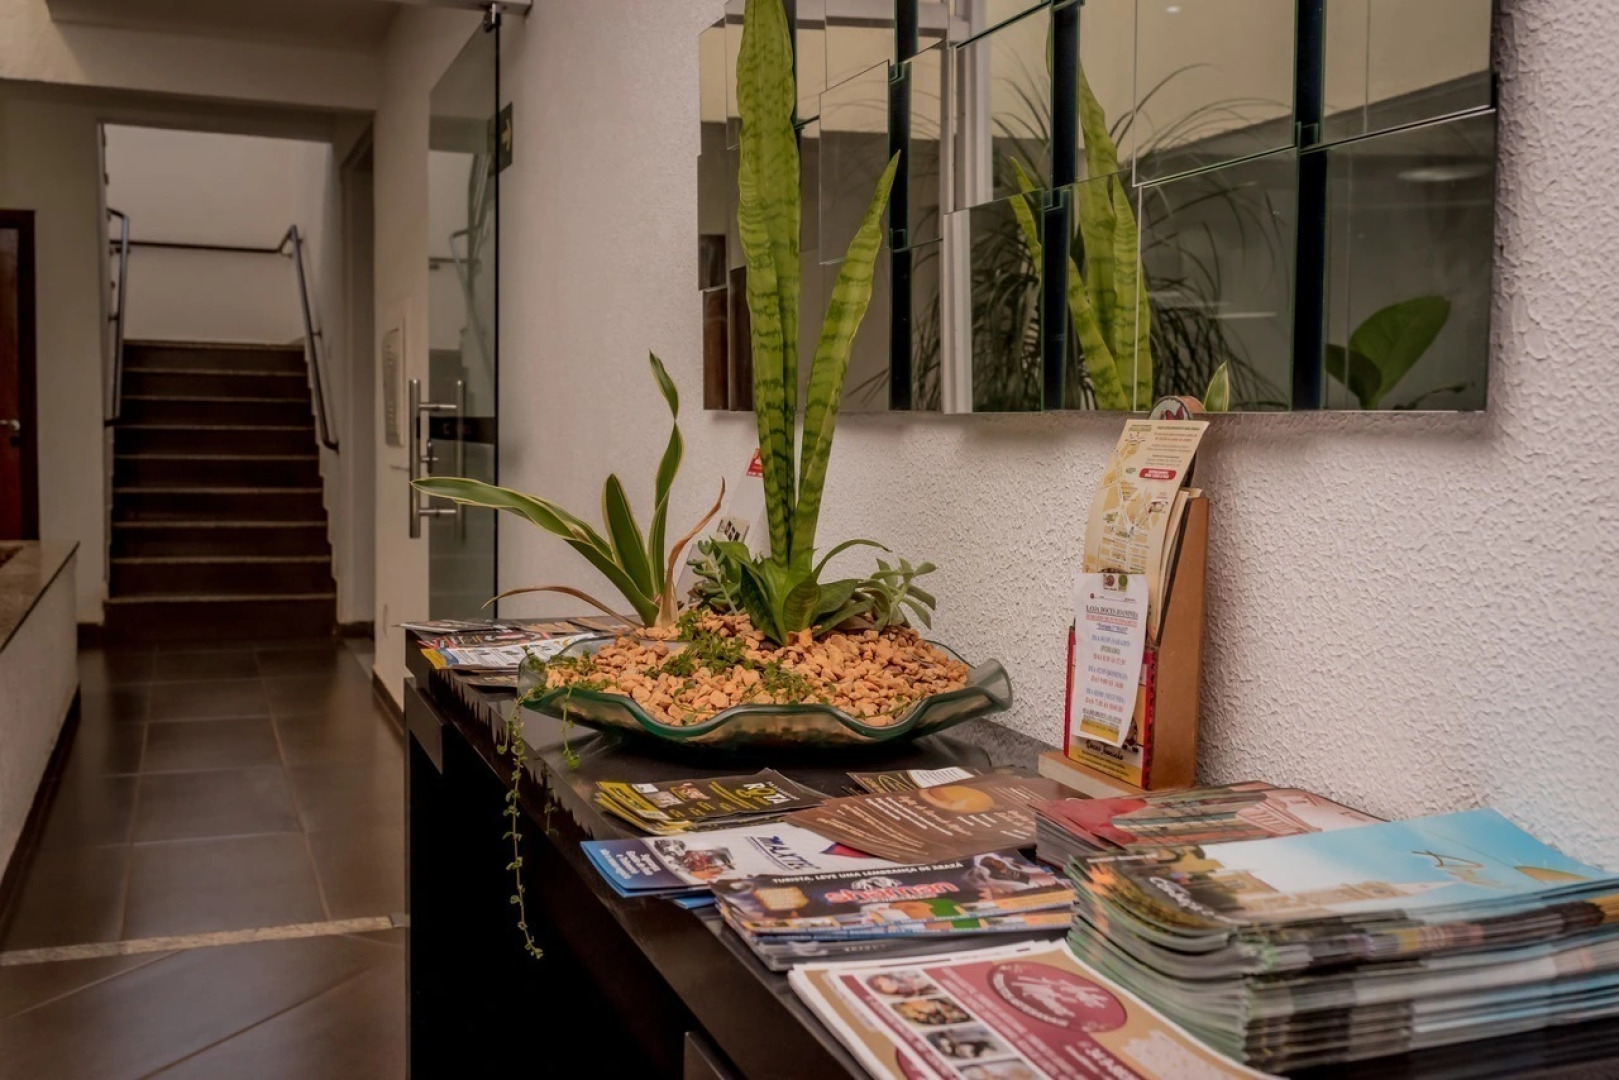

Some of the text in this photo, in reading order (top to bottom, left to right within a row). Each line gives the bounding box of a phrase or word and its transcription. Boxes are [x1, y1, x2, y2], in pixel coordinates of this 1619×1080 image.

[816, 873, 837, 881] LEVE
[839, 871, 861, 879] UMA
[919, 865, 931, 873] DE
